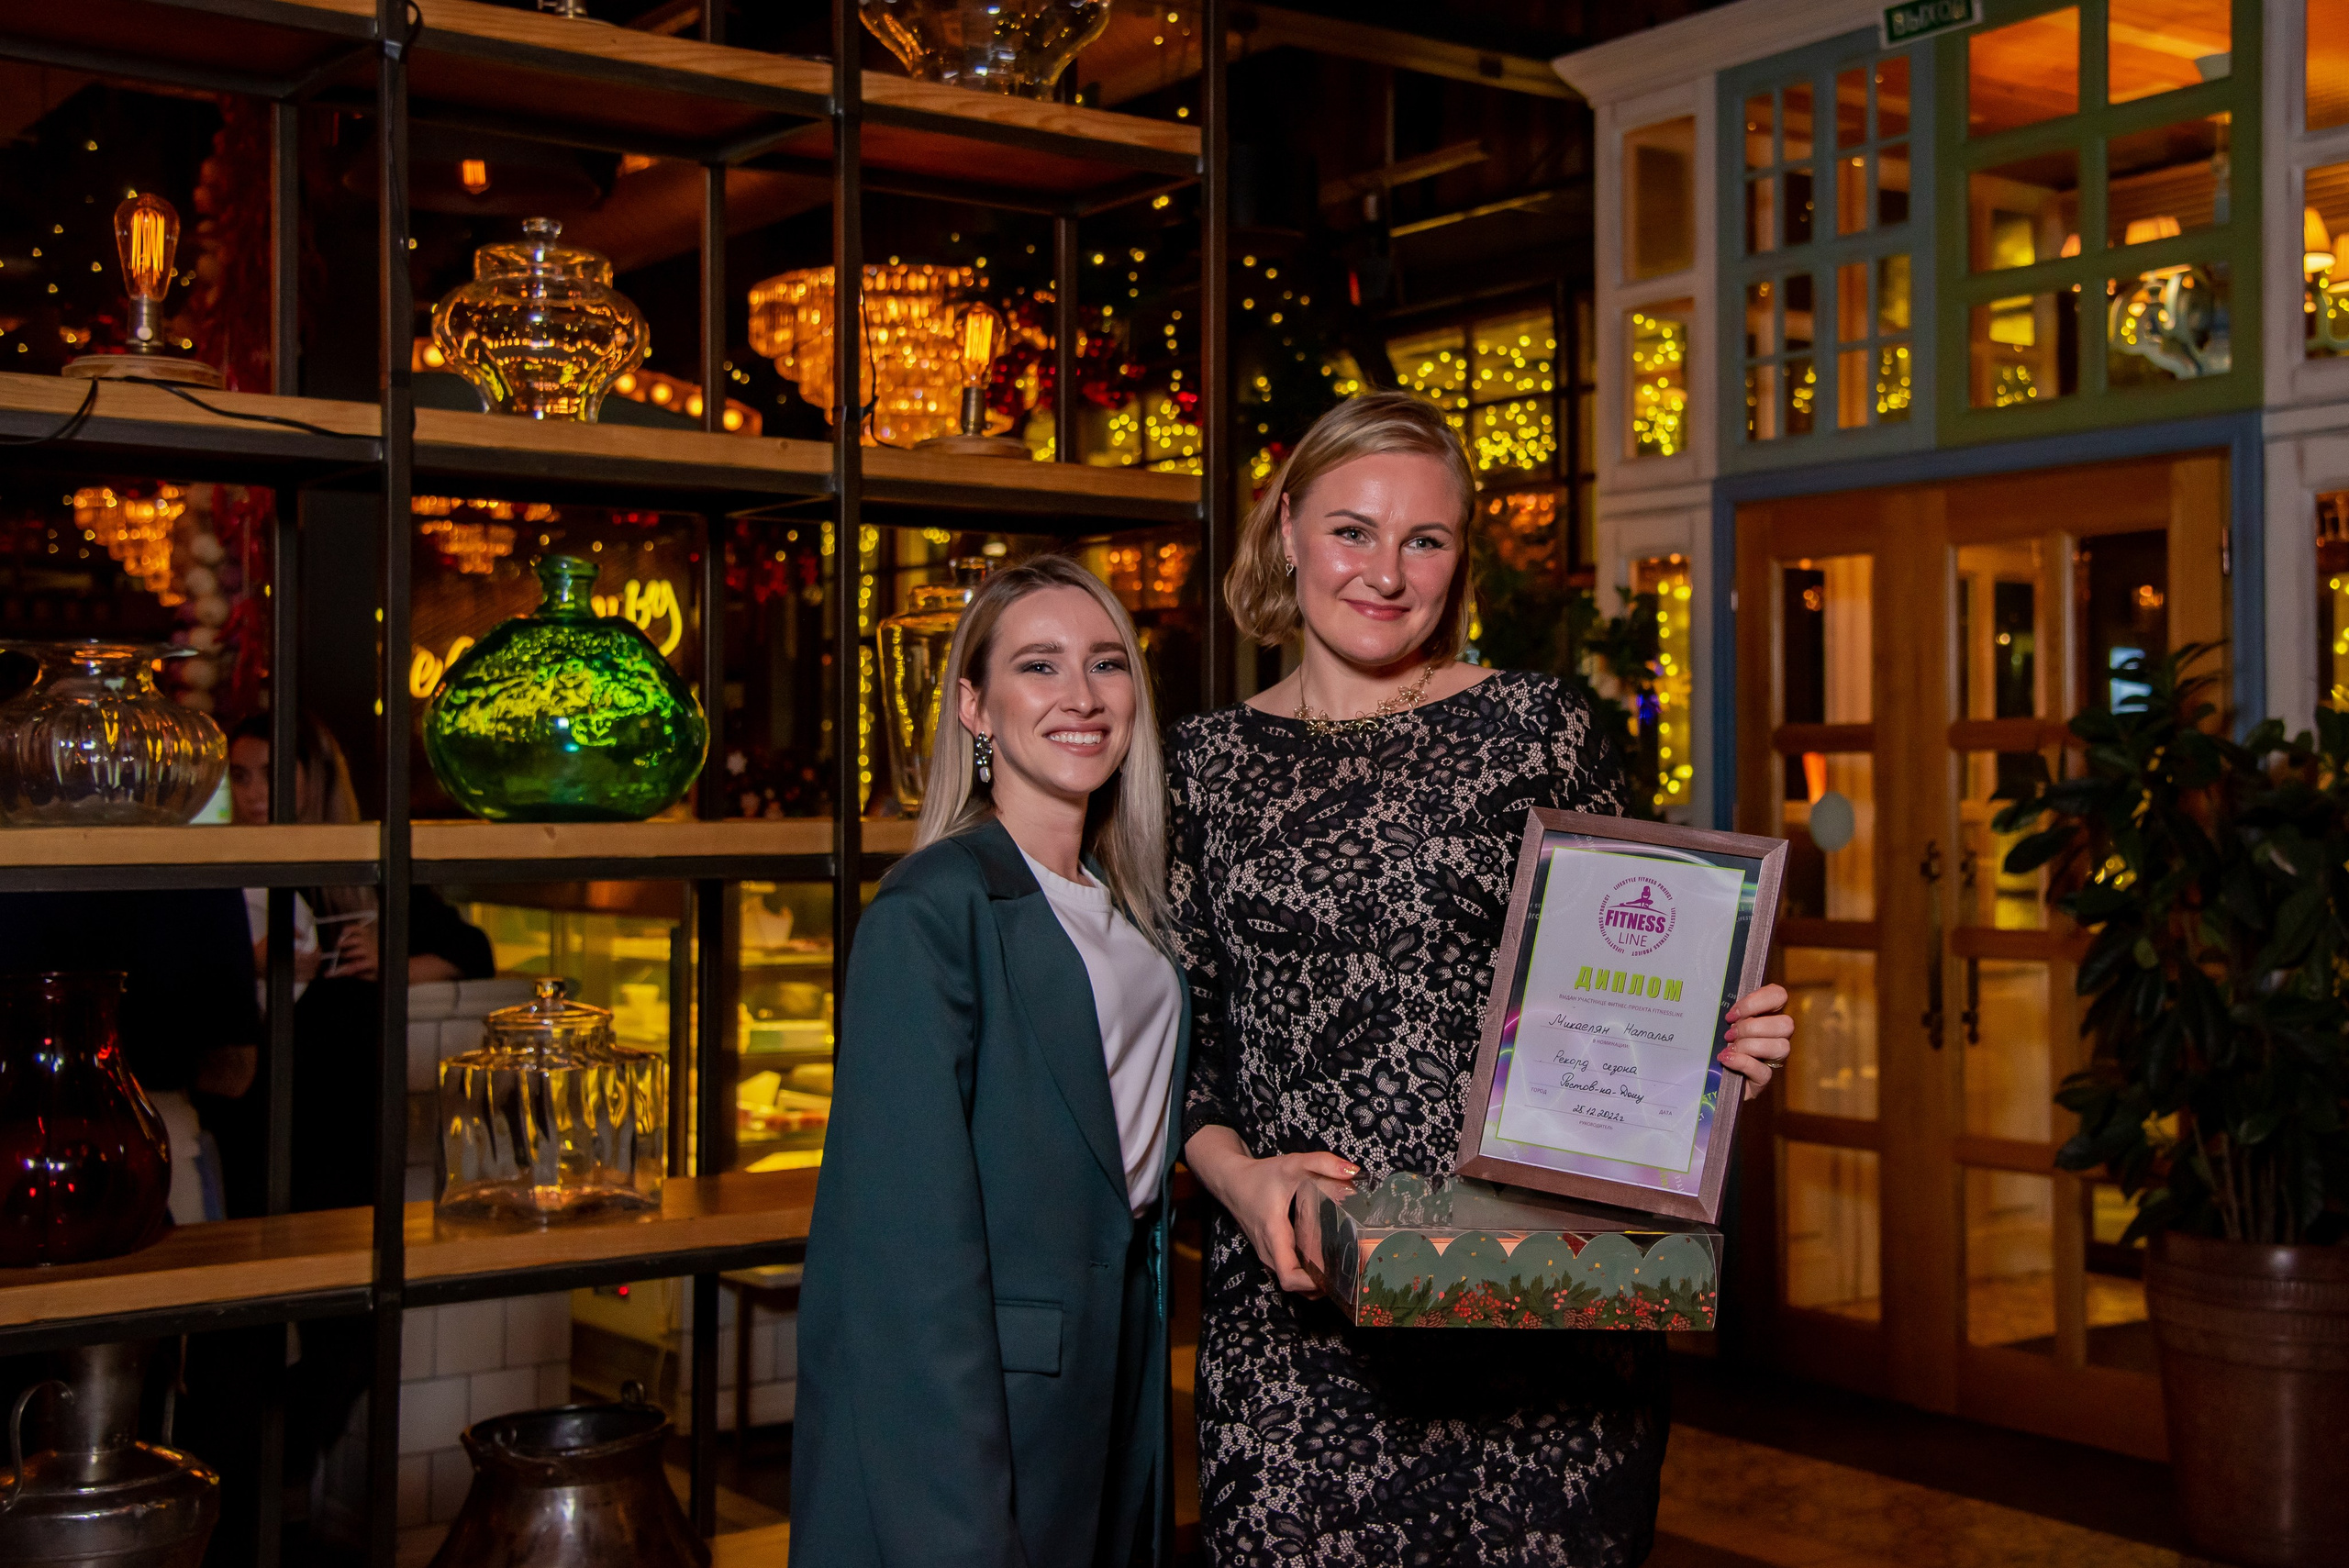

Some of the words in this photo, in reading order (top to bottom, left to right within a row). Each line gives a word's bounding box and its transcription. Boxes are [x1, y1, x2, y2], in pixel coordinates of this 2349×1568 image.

[1605, 909, 1666, 934] FITNESS
[1618, 931, 1648, 948] LINE
[1574, 965, 1684, 1002] ДИПЛОМ
[1558, 994, 1577, 1002] ВЫДАН
[1577, 995, 1607, 1006] УЧАСТНИЦЕ
[1548, 1013, 1610, 1035] Микаелян
[1623, 1022, 1675, 1042] Наталья
[1553, 1050, 1590, 1073] Рекорд
[1602, 1062, 1638, 1076] сезона
[1531, 1086, 1548, 1095] ГОРОД
[1578, 1120, 1613, 1130] РУКОВОДИТЕЛЬ
